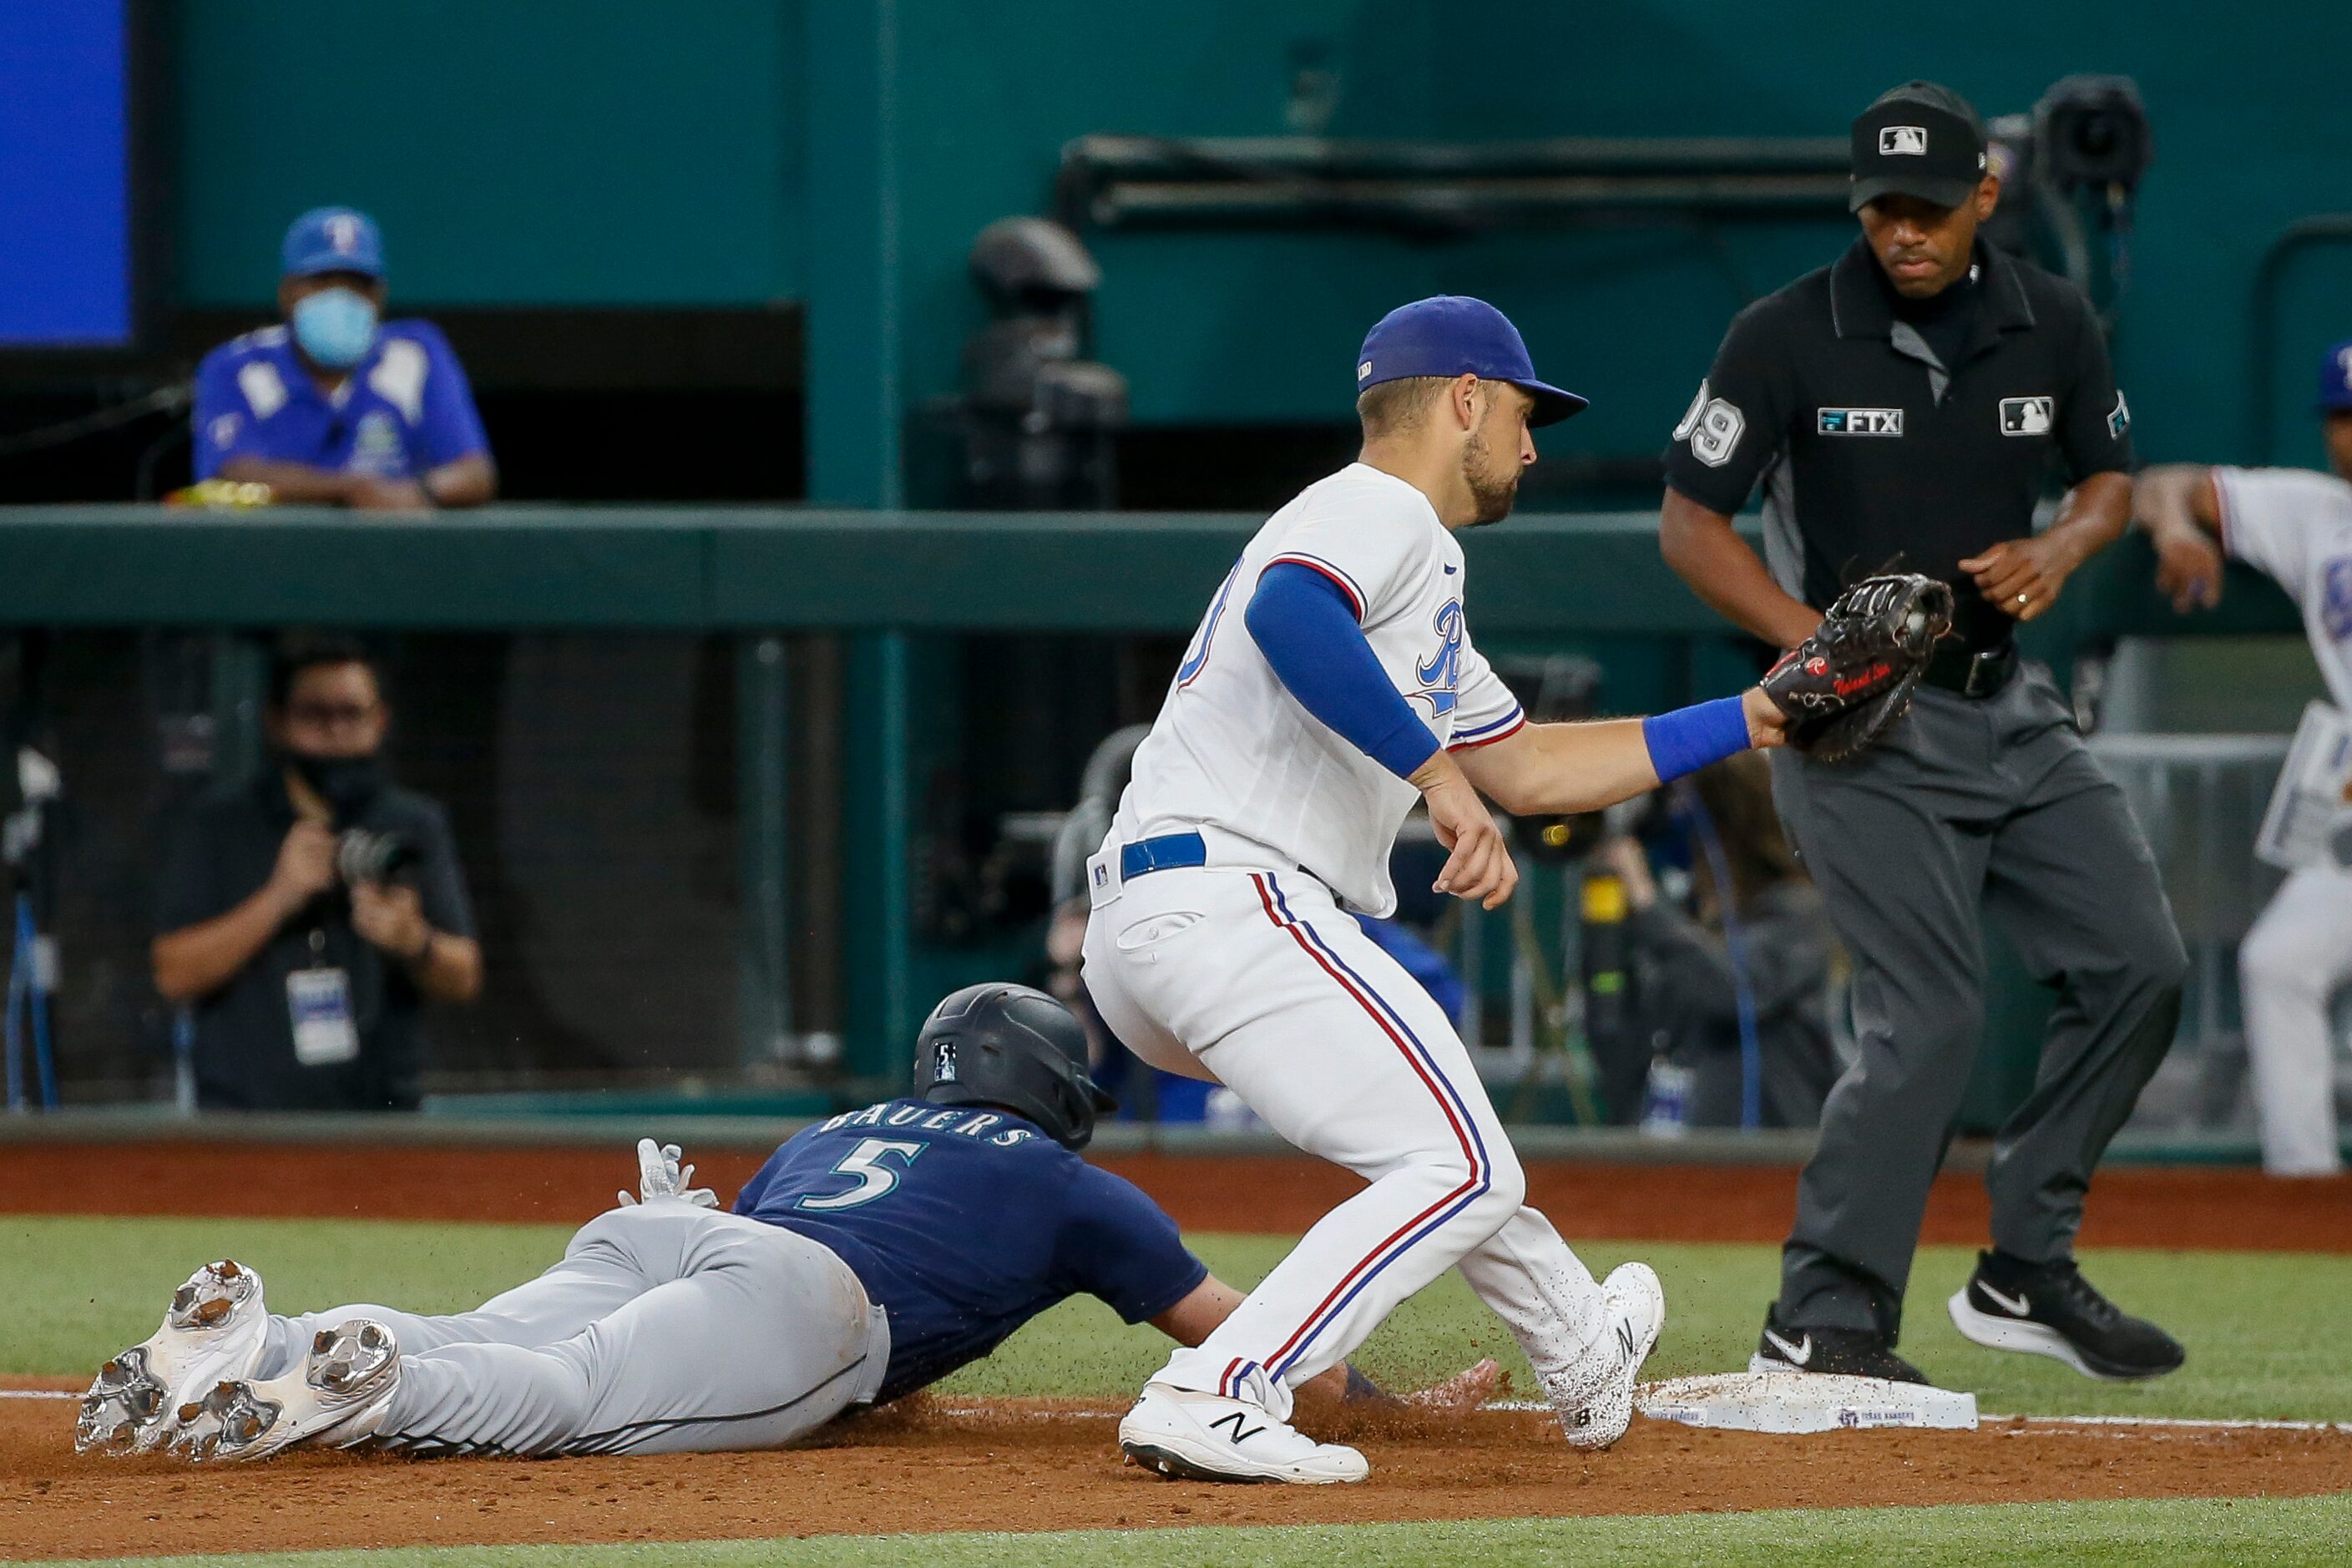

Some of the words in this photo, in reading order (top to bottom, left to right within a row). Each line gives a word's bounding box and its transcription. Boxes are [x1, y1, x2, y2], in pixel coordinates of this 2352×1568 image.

[1848, 412, 1899, 432] FTX
[940, 1044, 949, 1065] 5
[812, 1102, 1039, 1146] BAUERS
[794, 1136, 930, 1211] 5
